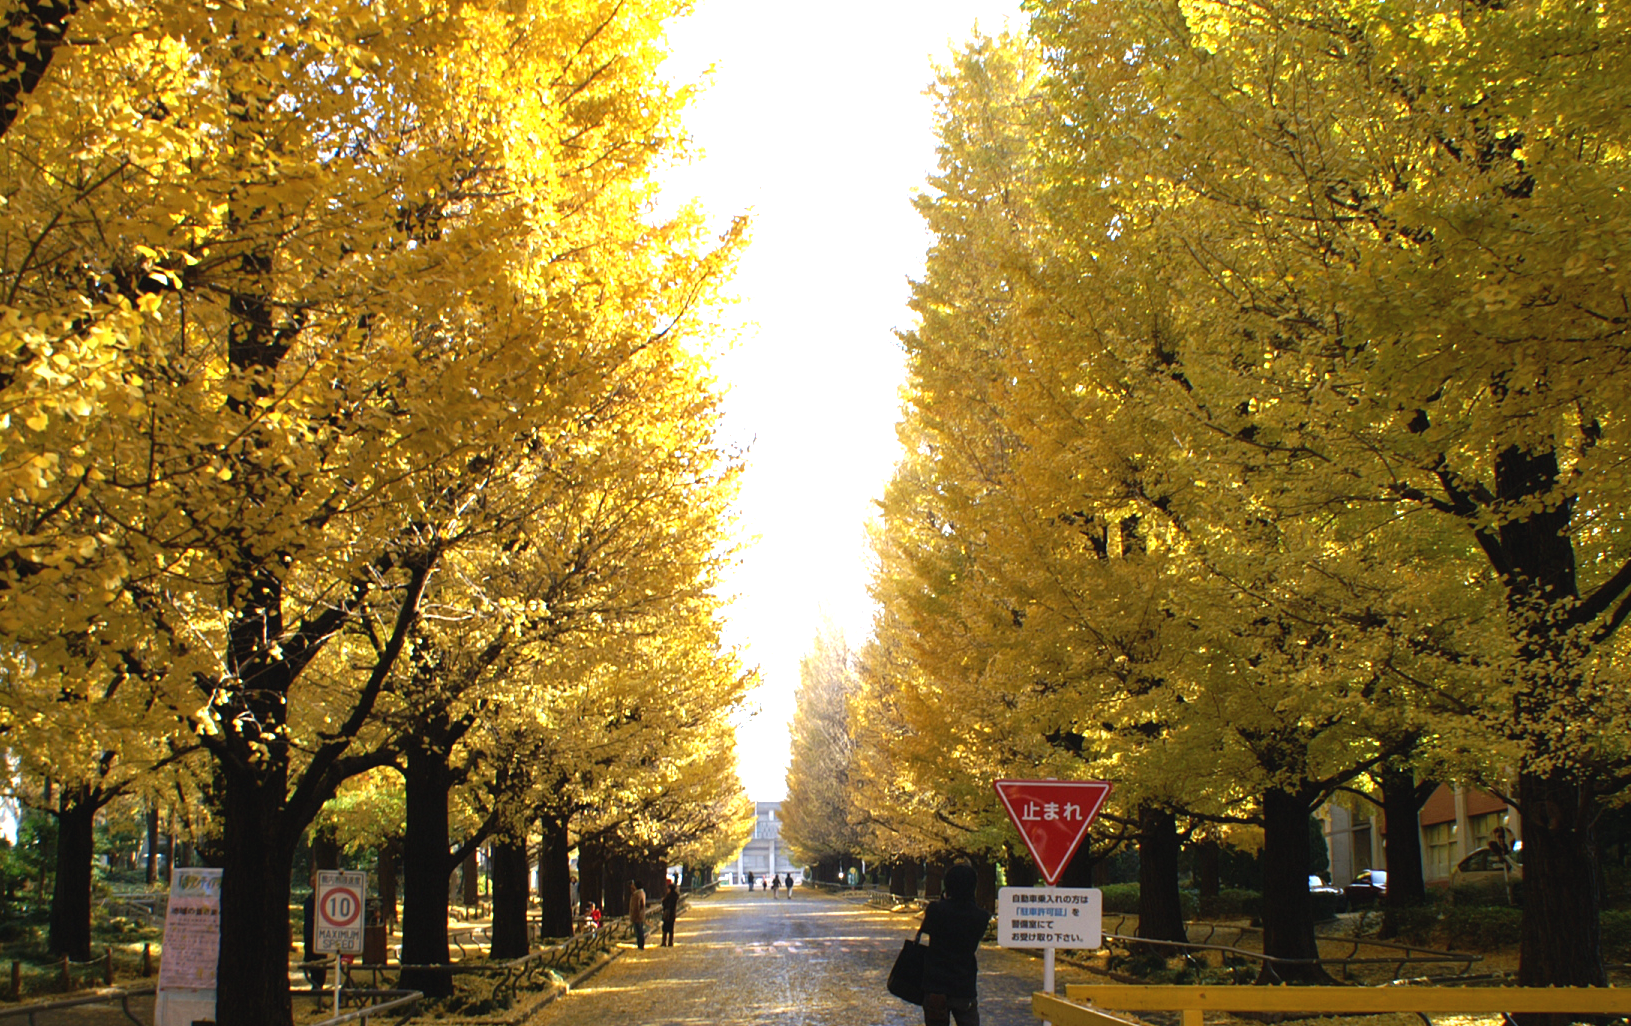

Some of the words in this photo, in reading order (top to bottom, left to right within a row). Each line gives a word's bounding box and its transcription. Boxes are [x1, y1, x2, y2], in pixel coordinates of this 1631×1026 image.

[1022, 801, 1083, 821] 止まれ
[1012, 894, 1089, 904] 自動車乗入れの方は
[330, 896, 351, 918] 10
[1011, 919, 1054, 929] 警備室にて
[319, 930, 360, 940] MAXIMUM
[1011, 932, 1084, 942] お受け取り下さい。
